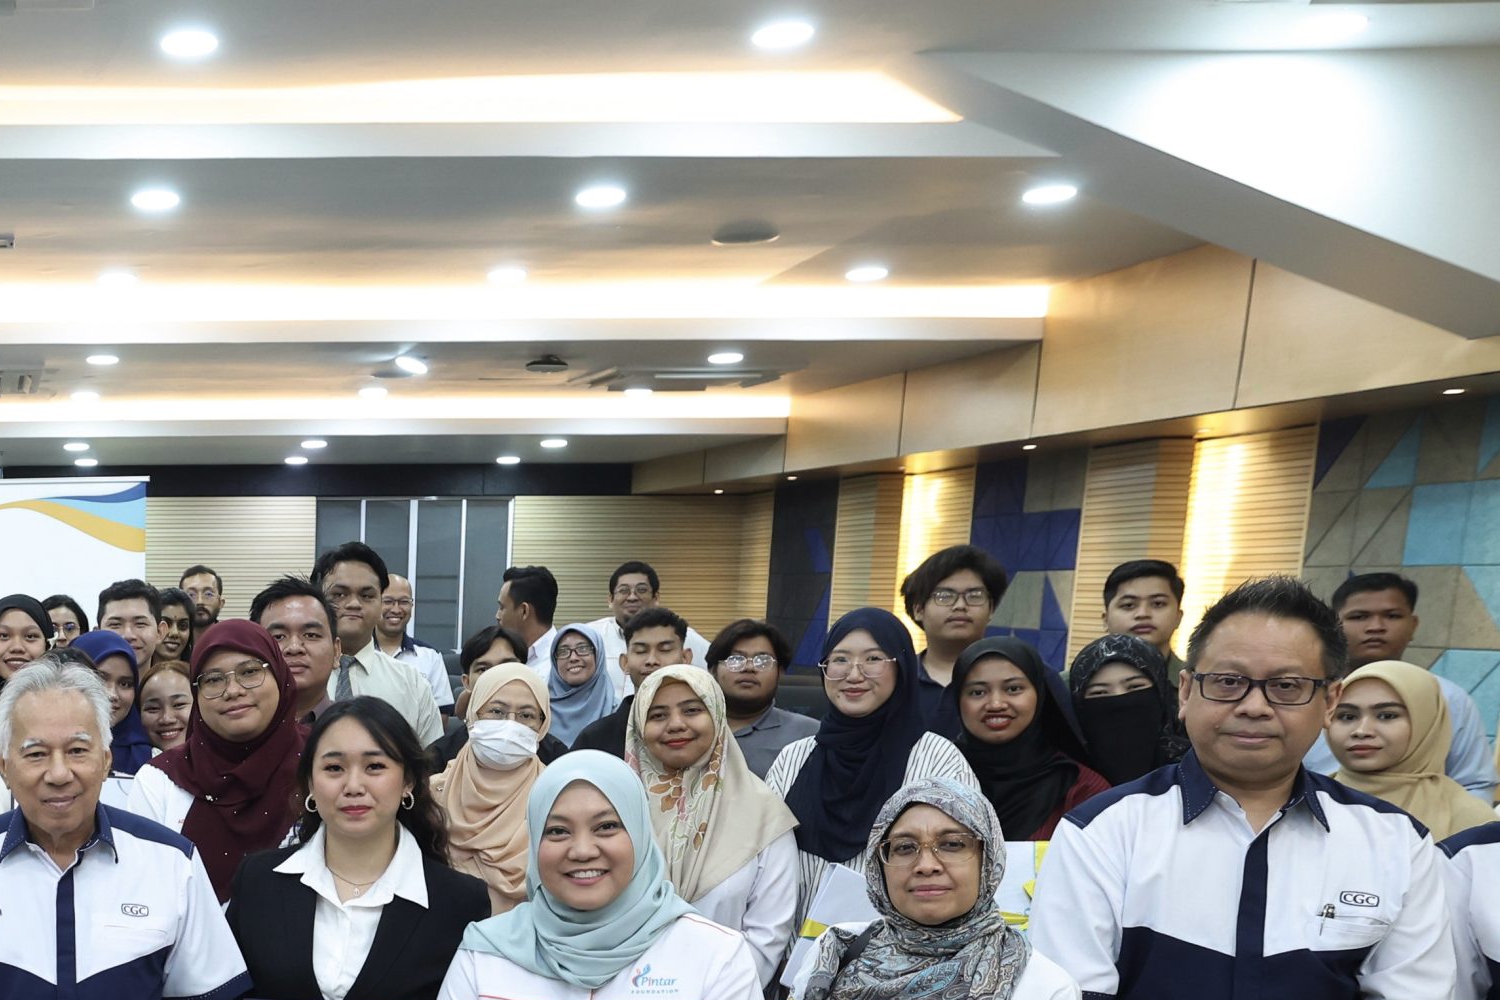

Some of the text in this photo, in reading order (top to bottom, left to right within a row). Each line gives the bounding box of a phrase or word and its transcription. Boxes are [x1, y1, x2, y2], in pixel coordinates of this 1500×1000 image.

[1343, 893, 1376, 906] CGC
[123, 905, 147, 915] CGC
[641, 976, 677, 986] Pintar
